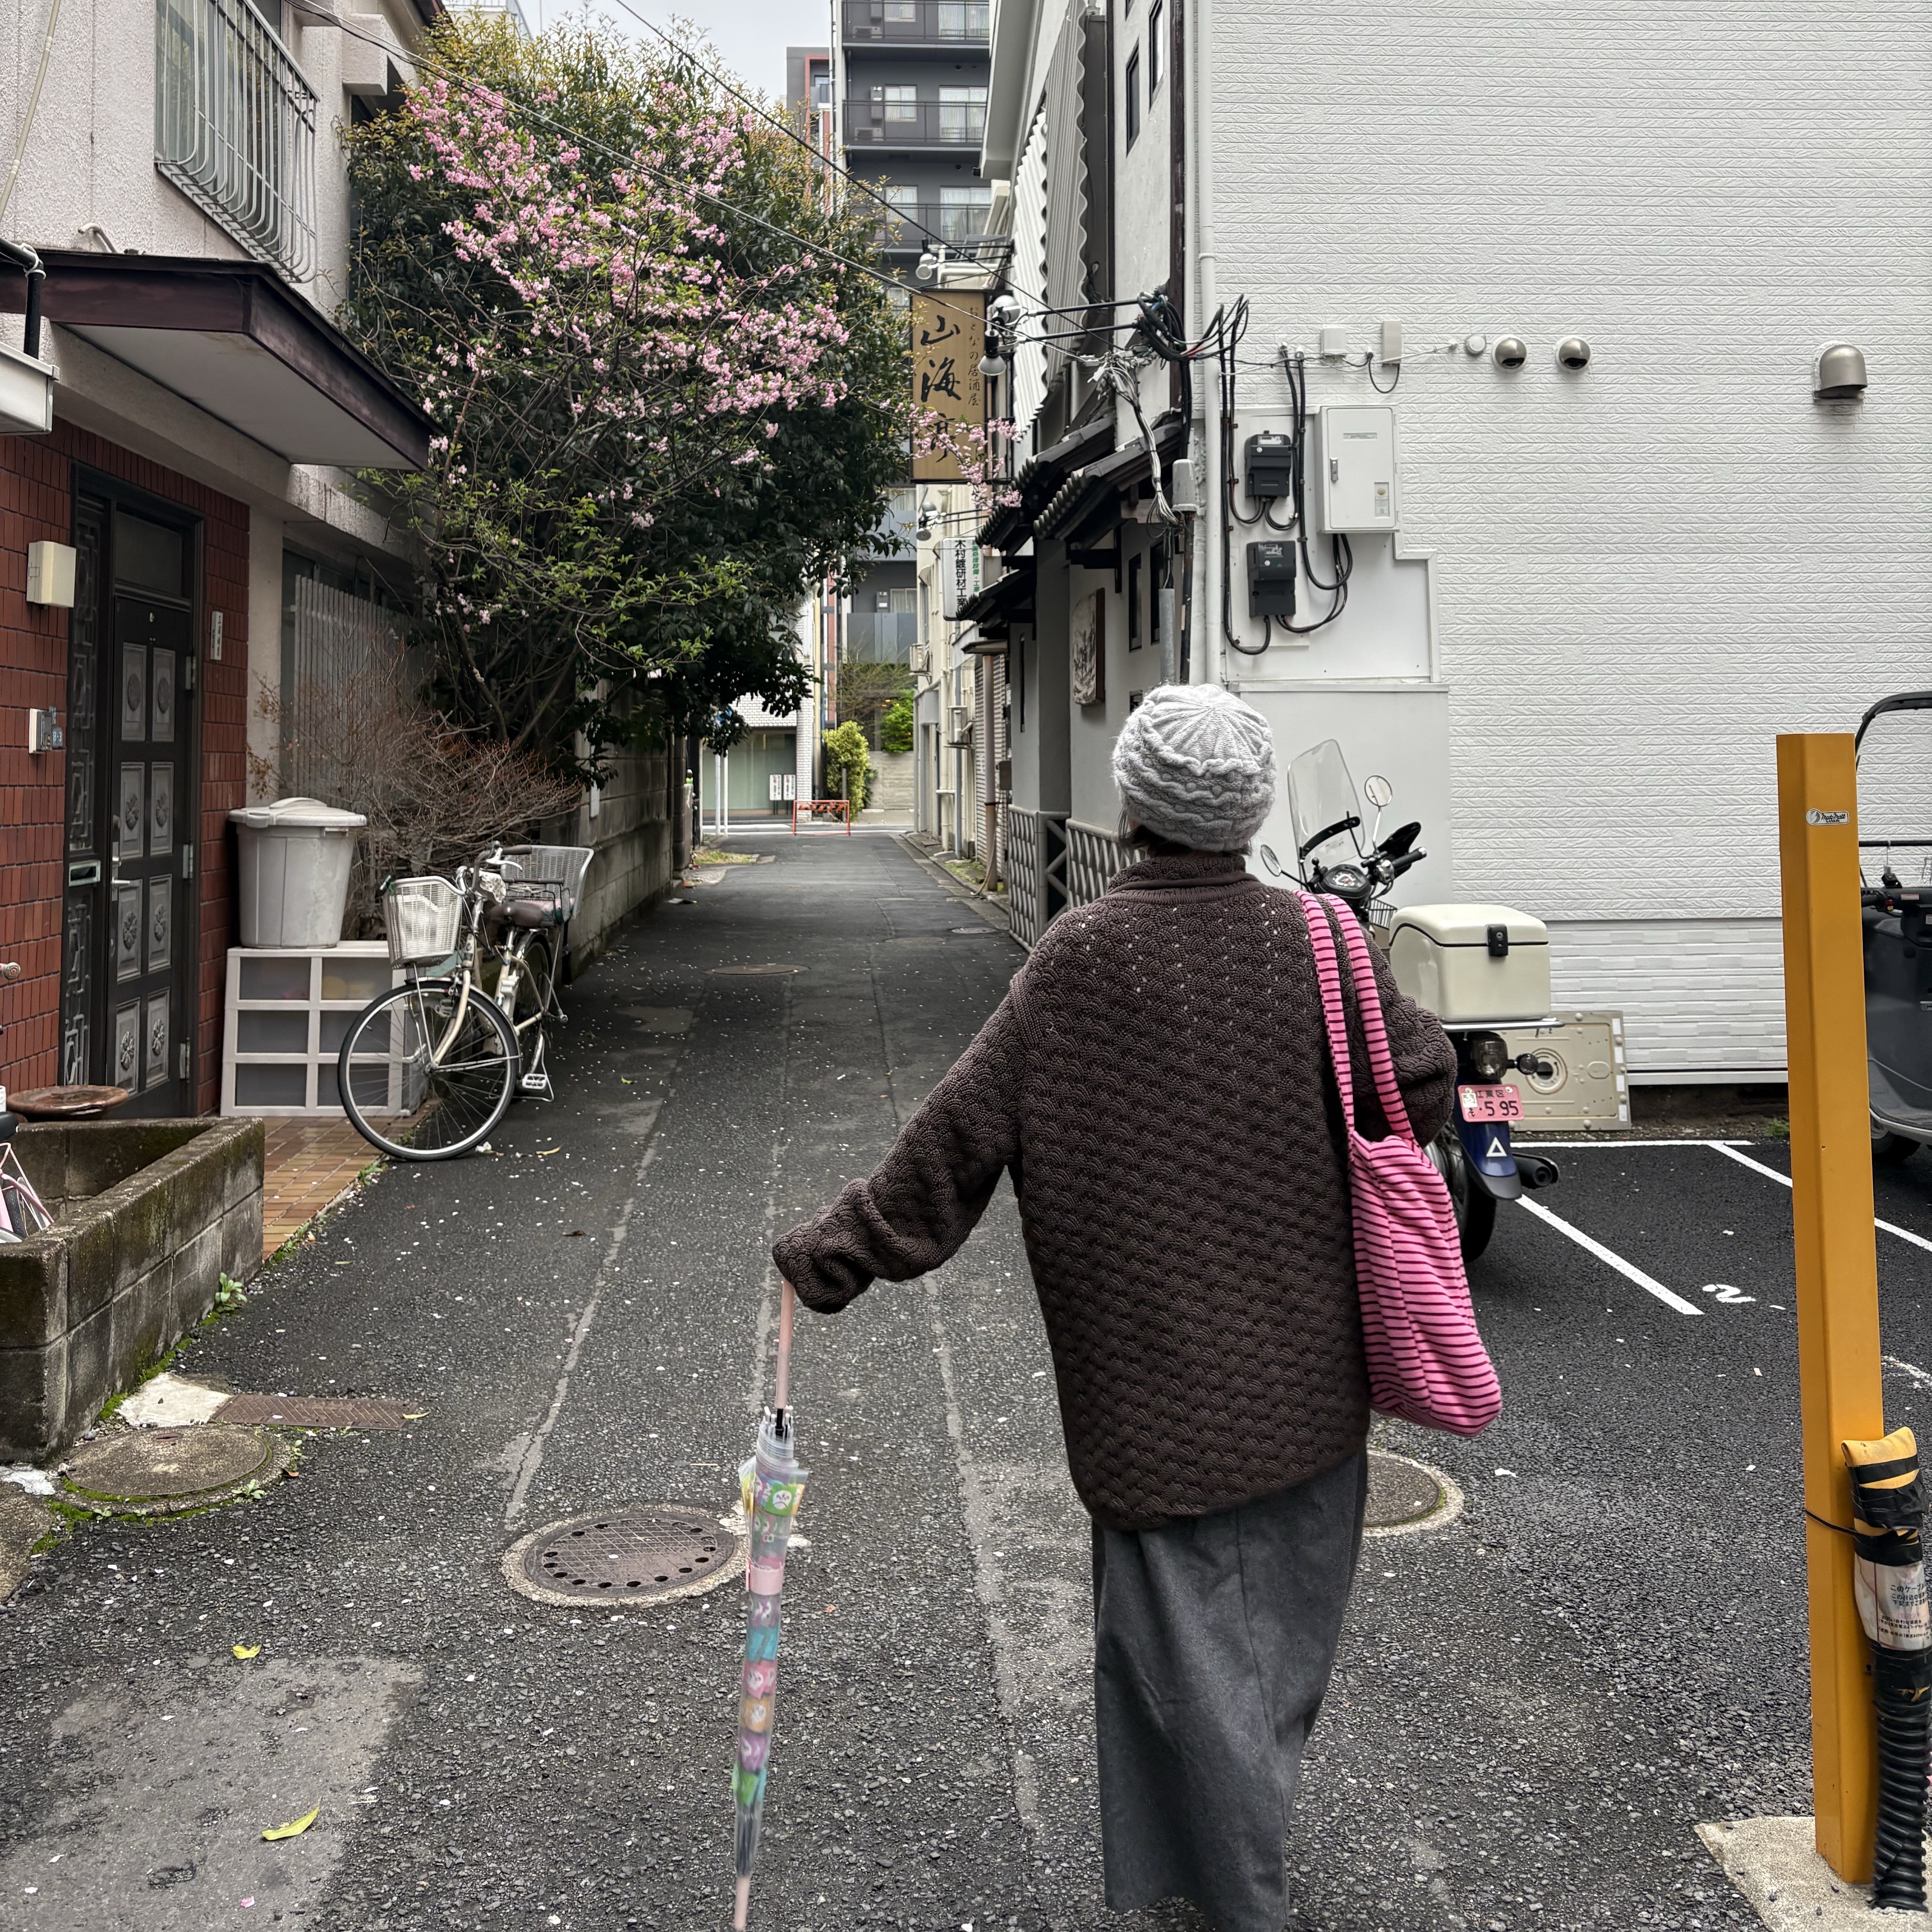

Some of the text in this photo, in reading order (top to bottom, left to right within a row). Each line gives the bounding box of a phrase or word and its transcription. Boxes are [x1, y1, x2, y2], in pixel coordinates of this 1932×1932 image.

[1474, 1090, 1505, 1098] 江東区
[1702, 1283, 1757, 1303] 2
